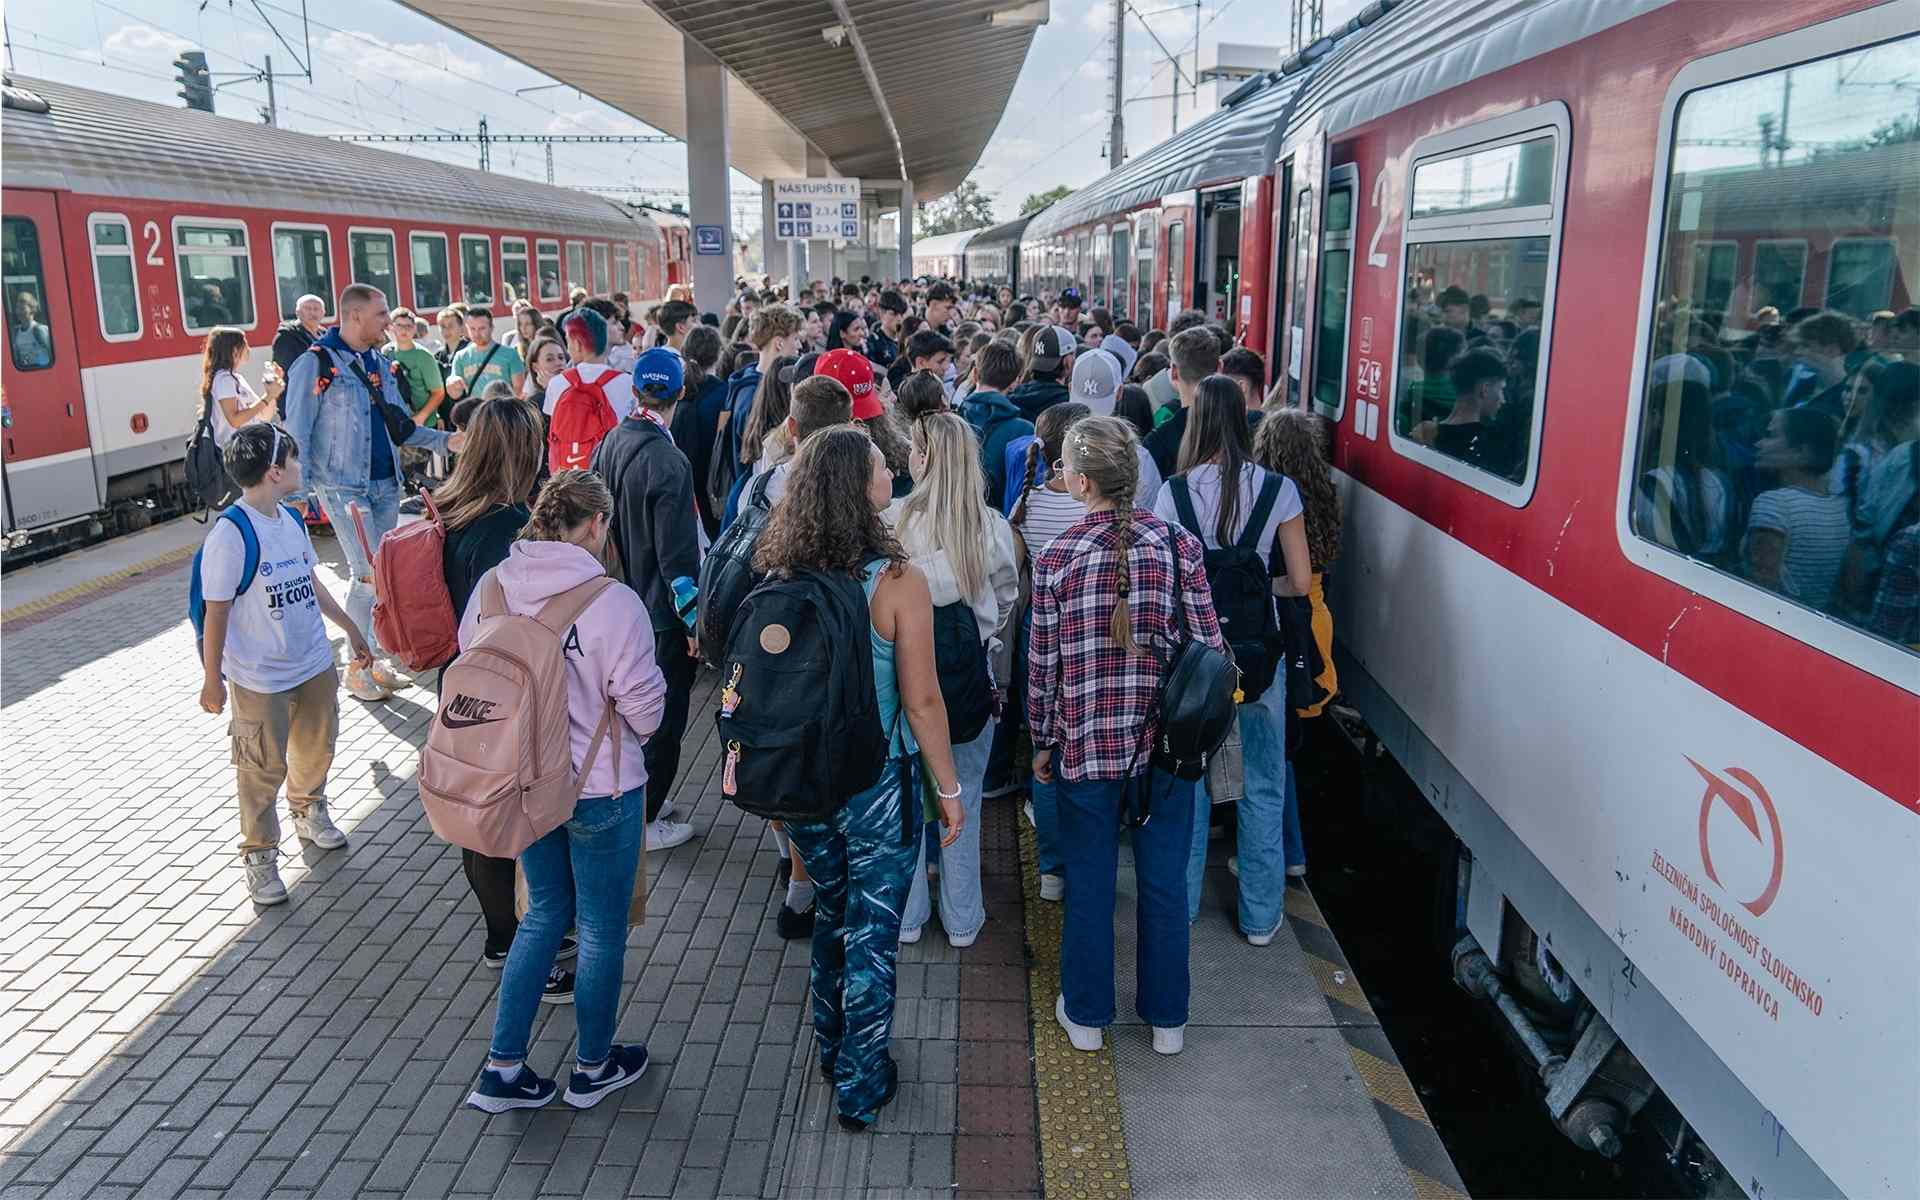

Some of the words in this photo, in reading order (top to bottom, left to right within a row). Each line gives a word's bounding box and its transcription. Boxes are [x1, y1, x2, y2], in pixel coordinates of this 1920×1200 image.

[779, 182, 847, 193] NÁSTUPIŠTE
[143, 220, 165, 266] 2
[268, 593, 284, 608] JE
[449, 694, 496, 720] NIKE
[1652, 848, 1699, 905] ŽELEZNIČNÁ
[1700, 892, 1760, 959] SPOLOČNOSŤ
[1760, 947, 1824, 1017] SLOVENSKO
[1669, 905, 1717, 961] NÁRODNÝ
[1719, 951, 1780, 1021] DOPRAVCA
